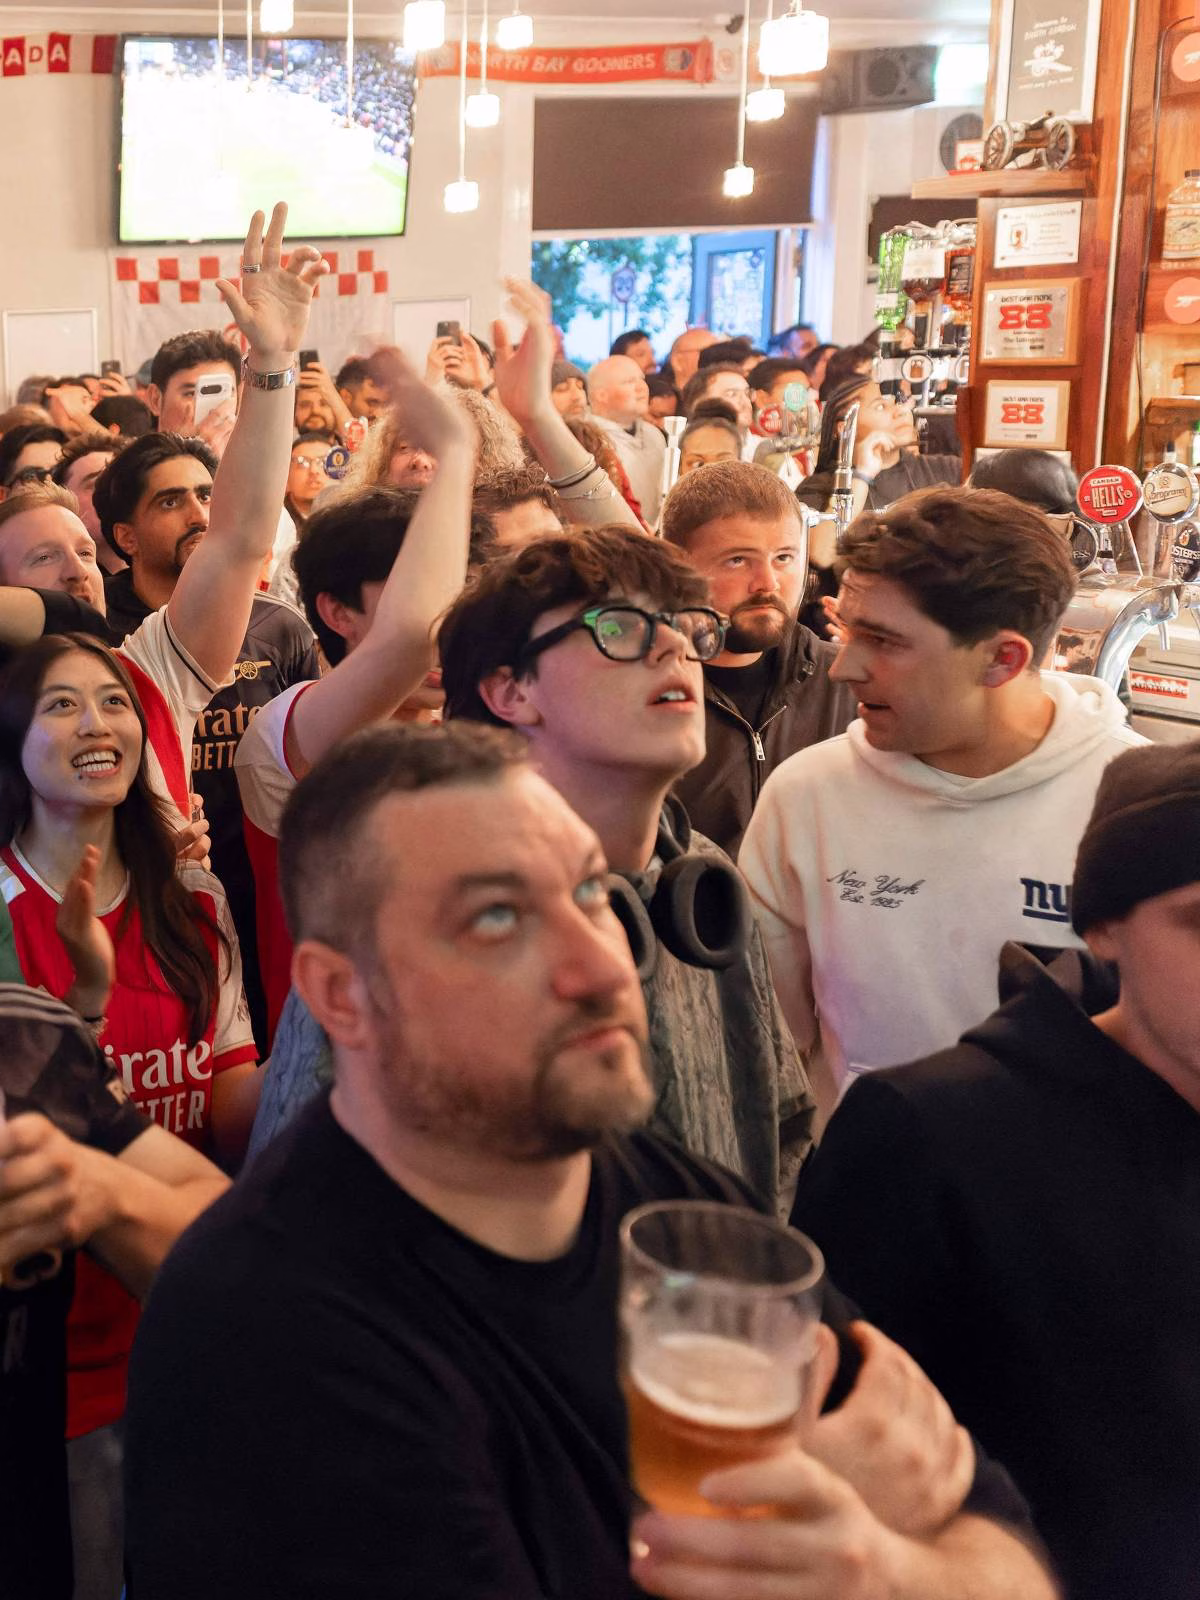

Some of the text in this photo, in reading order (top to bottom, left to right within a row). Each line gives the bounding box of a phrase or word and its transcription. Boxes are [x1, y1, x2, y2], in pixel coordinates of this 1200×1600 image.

[532, 54, 570, 73] BAY
[572, 52, 656, 74] GOONERS
[1091, 486, 1125, 508] HELLS
[191, 741, 237, 771] BETT
[826, 870, 926, 897] New York
[135, 1090, 206, 1133] TTER
